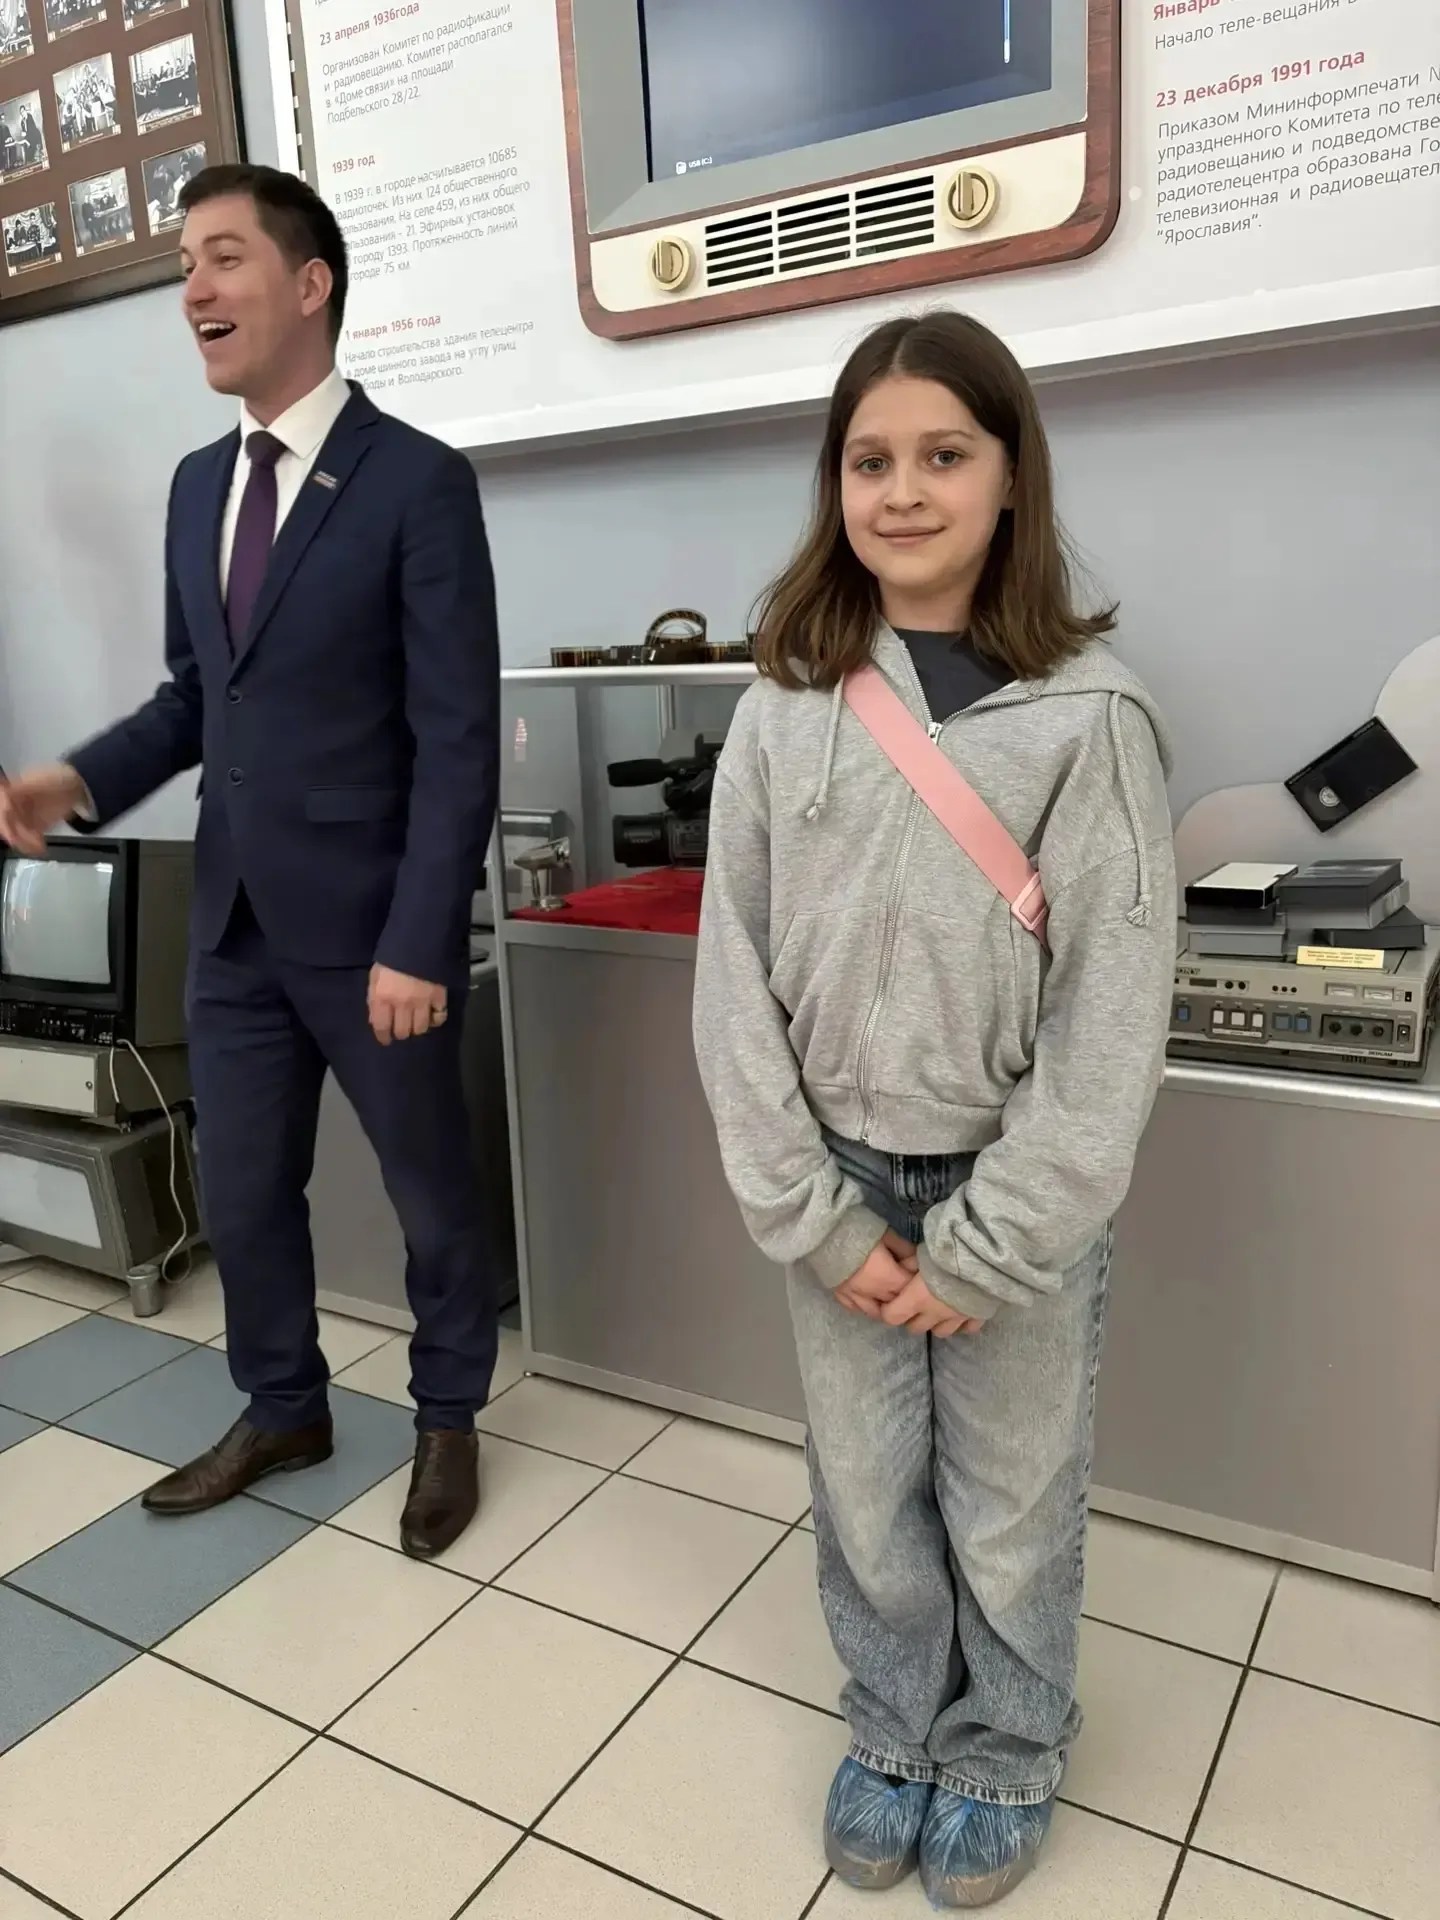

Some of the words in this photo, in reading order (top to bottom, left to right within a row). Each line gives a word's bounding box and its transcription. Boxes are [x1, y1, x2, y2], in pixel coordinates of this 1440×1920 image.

[1153, 0, 1220, 20] Январь
[1155, 26, 1214, 50] Начало
[1219, 0, 1340, 35] теле-вещания
[320, 33, 331, 46] 23
[334, 19, 370, 40] апреля
[322, 49, 380, 77] Организован
[383, 34, 420, 55] Комитет
[422, 31, 434, 44] по
[436, 3, 511, 40] радиофикации
[324, 82, 331, 92] и
[406, 44, 445, 65] Комитет
[447, 21, 513, 53] располагался
[325, 98, 332, 108] в
[334, 87, 363, 107] «Доме
[364, 77, 395, 96] связи»
[397, 74, 409, 85] на
[411, 58, 454, 81] площади
[1156, 91, 1177, 108] 23
[1183, 73, 1263, 104] декабря
[1271, 60, 1311, 83] 1991
[1318, 51, 1365, 73] года
[327, 96, 390, 125] Подбельского
[1158, 112, 1240, 139] Приказом
[1247, 73, 1420, 121] Мининформпечати
[1158, 124, 1282, 164] упраздненного
[1288, 106, 1370, 134] Комитета
[1378, 100, 1400, 116] по
[332, 158, 354, 174] 1939
[357, 154, 376, 168] год
[335, 193, 342, 205] В
[344, 186, 364, 203] 1939
[375, 184, 382, 195] в
[384, 175, 416, 196] городе
[417, 156, 486, 183] насчитывается
[488, 146, 517, 165] 10685
[1157, 147, 1285, 184] радиовещанию
[1292, 144, 1303, 156] и
[1157, 164, 1299, 207] радиотелецентра
[1306, 142, 1412, 175] образована
[392, 195, 405, 208] Из
[406, 190, 423, 204] них
[426, 183, 441, 199] 124
[443, 165, 518, 194] общественного
[398, 208, 412, 221] На
[414, 203, 435, 219] селе
[436, 197, 458, 217] 459,
[459, 195, 471, 208] из
[472, 190, 490, 204] них
[492, 180, 531, 202] общего
[1156, 190, 1279, 225] телевизионная
[1290, 187, 1301, 200] и
[419, 213, 464, 237] Эфирных
[467, 202, 516, 227] установок
[353, 250, 385, 267] городу
[412, 228, 484, 254] Протяженность
[486, 216, 519, 237] линий
[384, 260, 395, 275] 75
[344, 349, 376, 365] Начало
[377, 337, 441, 359] строительства
[444, 331, 478, 348] здания
[480, 320, 534, 341] телецентра
[345, 329, 350, 342] 1
[352, 322, 388, 340] января
[391, 317, 414, 333] 1956
[417, 313, 441, 329] года
[353, 363, 377, 379] доме
[378, 357, 417, 374] шинного
[419, 350, 452, 368] завода
[454, 349, 466, 361] на
[469, 343, 489, 361] углу
[492, 340, 517, 357] улиц
[363, 379, 387, 391] боды
[388, 377, 395, 387] и
